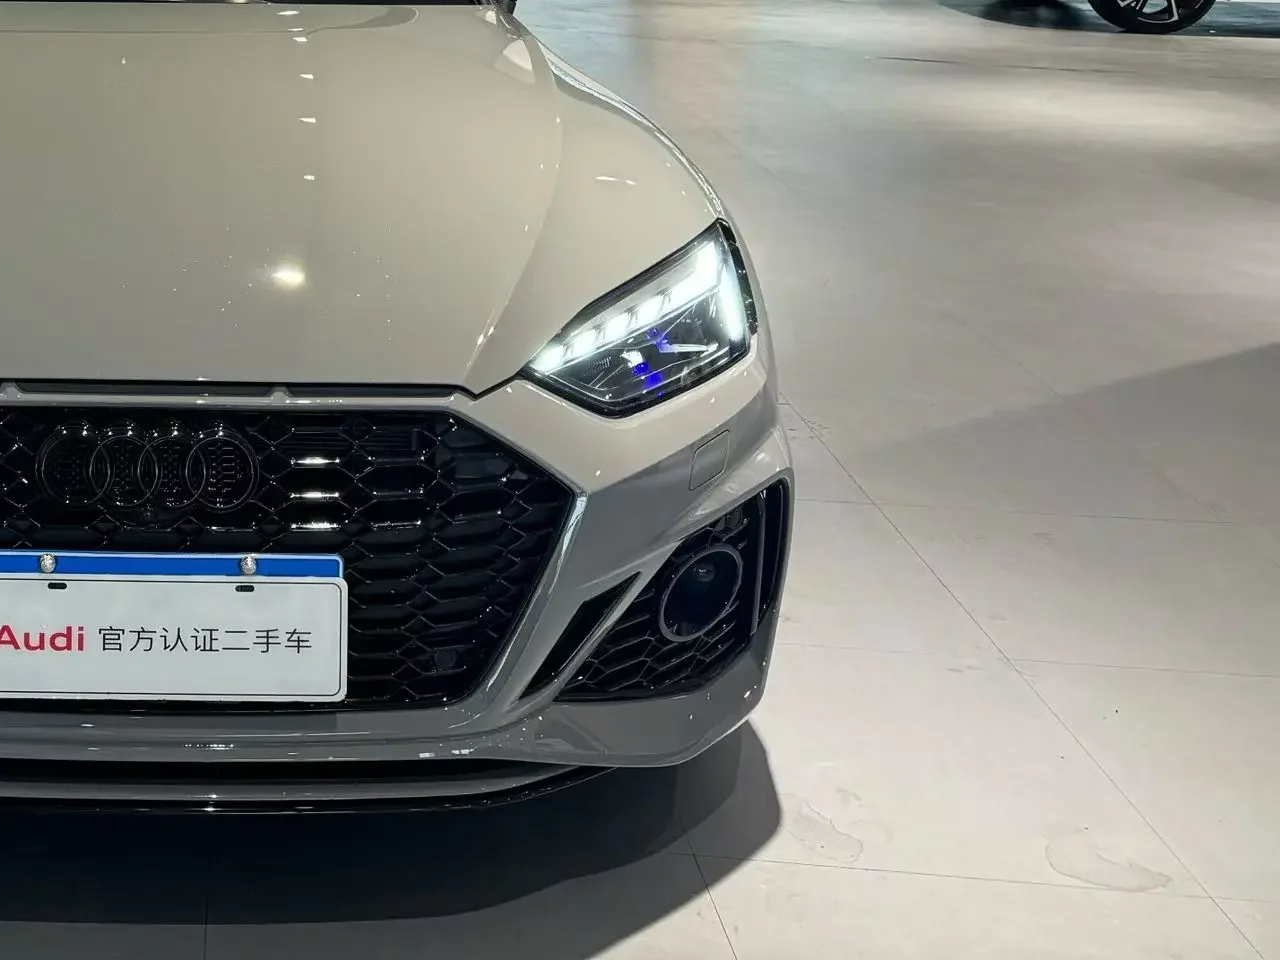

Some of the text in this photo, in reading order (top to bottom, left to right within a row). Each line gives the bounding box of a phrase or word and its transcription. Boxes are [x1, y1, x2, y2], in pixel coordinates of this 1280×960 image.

[97, 626, 313, 654] 官方认证二手车
